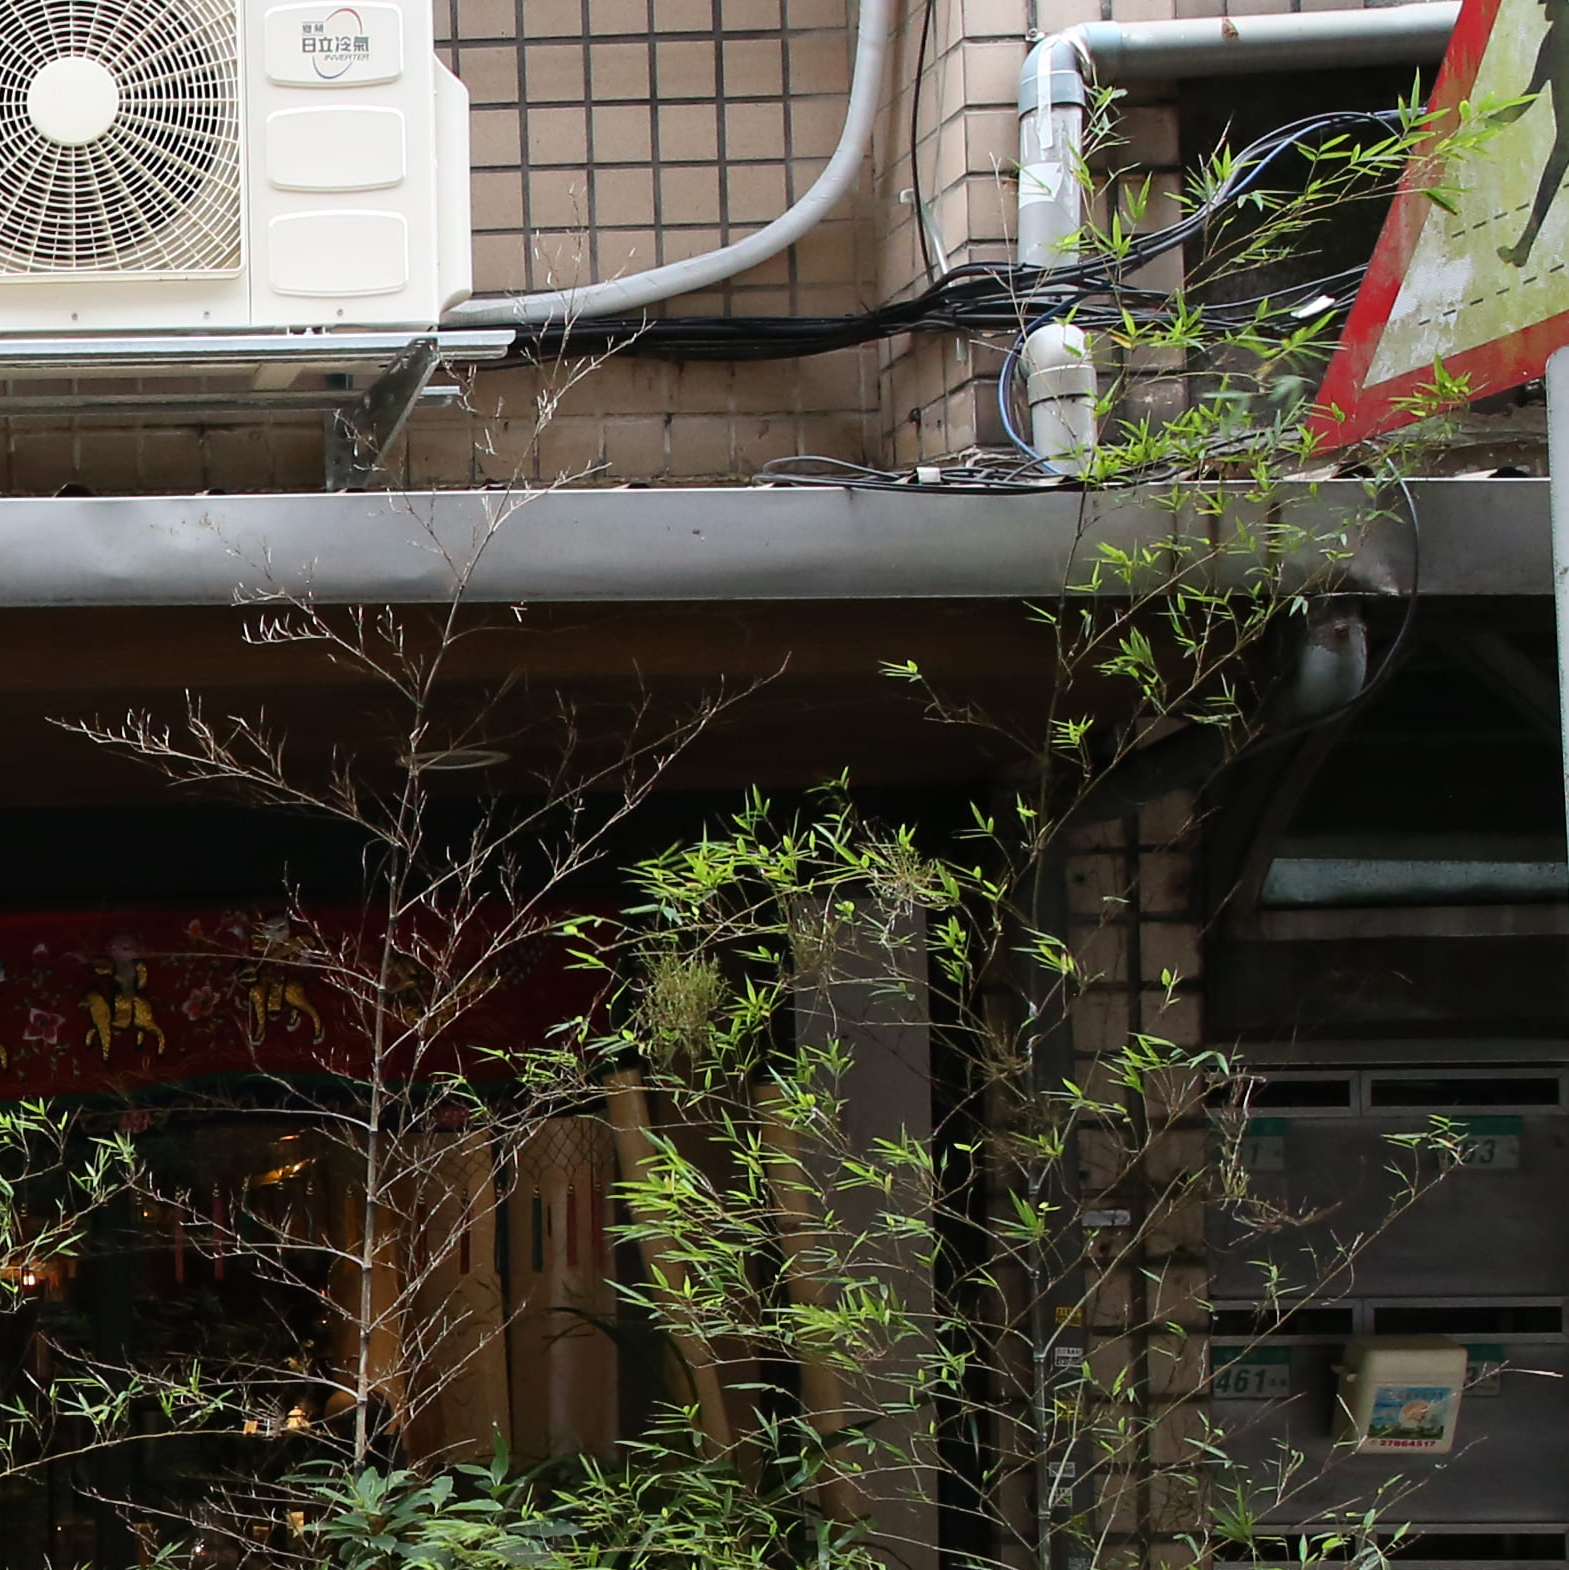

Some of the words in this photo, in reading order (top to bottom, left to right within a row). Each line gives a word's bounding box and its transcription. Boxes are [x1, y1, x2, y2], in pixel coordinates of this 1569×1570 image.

[302, 36, 369, 53] 日立冷氣
[1215, 1367, 1267, 1393] 461
